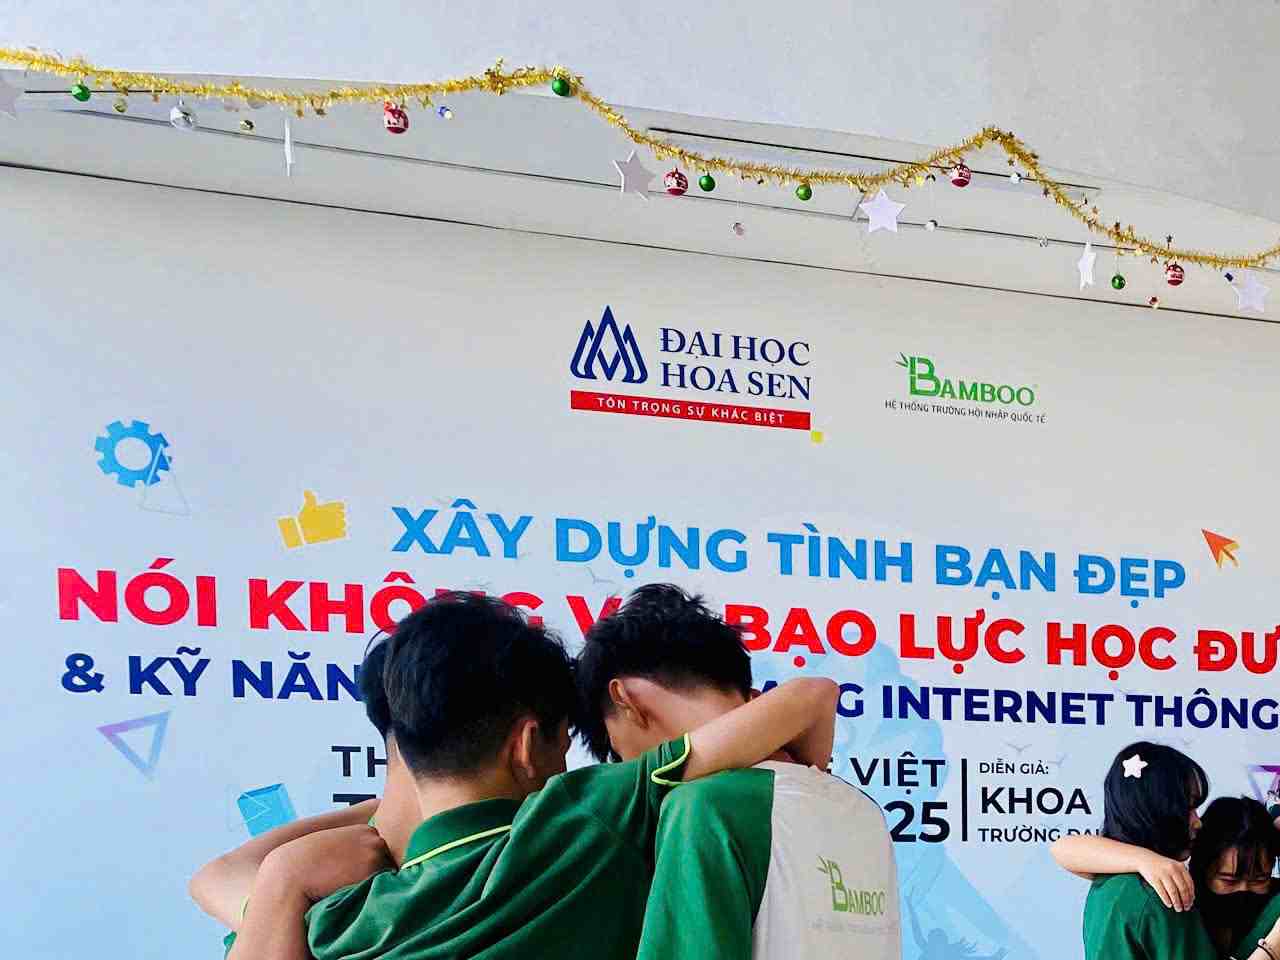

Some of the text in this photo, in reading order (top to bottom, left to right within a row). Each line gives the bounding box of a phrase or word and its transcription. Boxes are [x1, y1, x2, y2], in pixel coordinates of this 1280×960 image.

[659, 327, 811, 367] ĐẠI HỌC
[660, 362, 812, 401] HOA SEN
[908, 356, 1036, 407] BAMBOO
[596, 397, 785, 424] TÔN TRỌNG SỰ KHÁC BIỆT
[391, 497, 1187, 609] XÂY DỰNG TÌNH BẠN ĐẸP
[57, 557, 218, 628] NÓI
[248, 570, 545, 635] KHÔ
[725, 603, 878, 669] BẠO
[899, 608, 1026, 675] LỰC
[1046, 621, 1178, 682] HỌC
[61, 653, 105, 693] &
[128, 645, 212, 697] KỸ
[231, 650, 365, 702] NĂN
[881, 684, 1115, 727] INTERNET
[1125, 687, 1280, 731] THÔNG
[849, 751, 946, 795] VIỆT
[979, 757, 1015, 774] DIỄN
[981, 786, 1092, 815] KHOA
[977, 824, 1061, 843] TRƯỜNG
